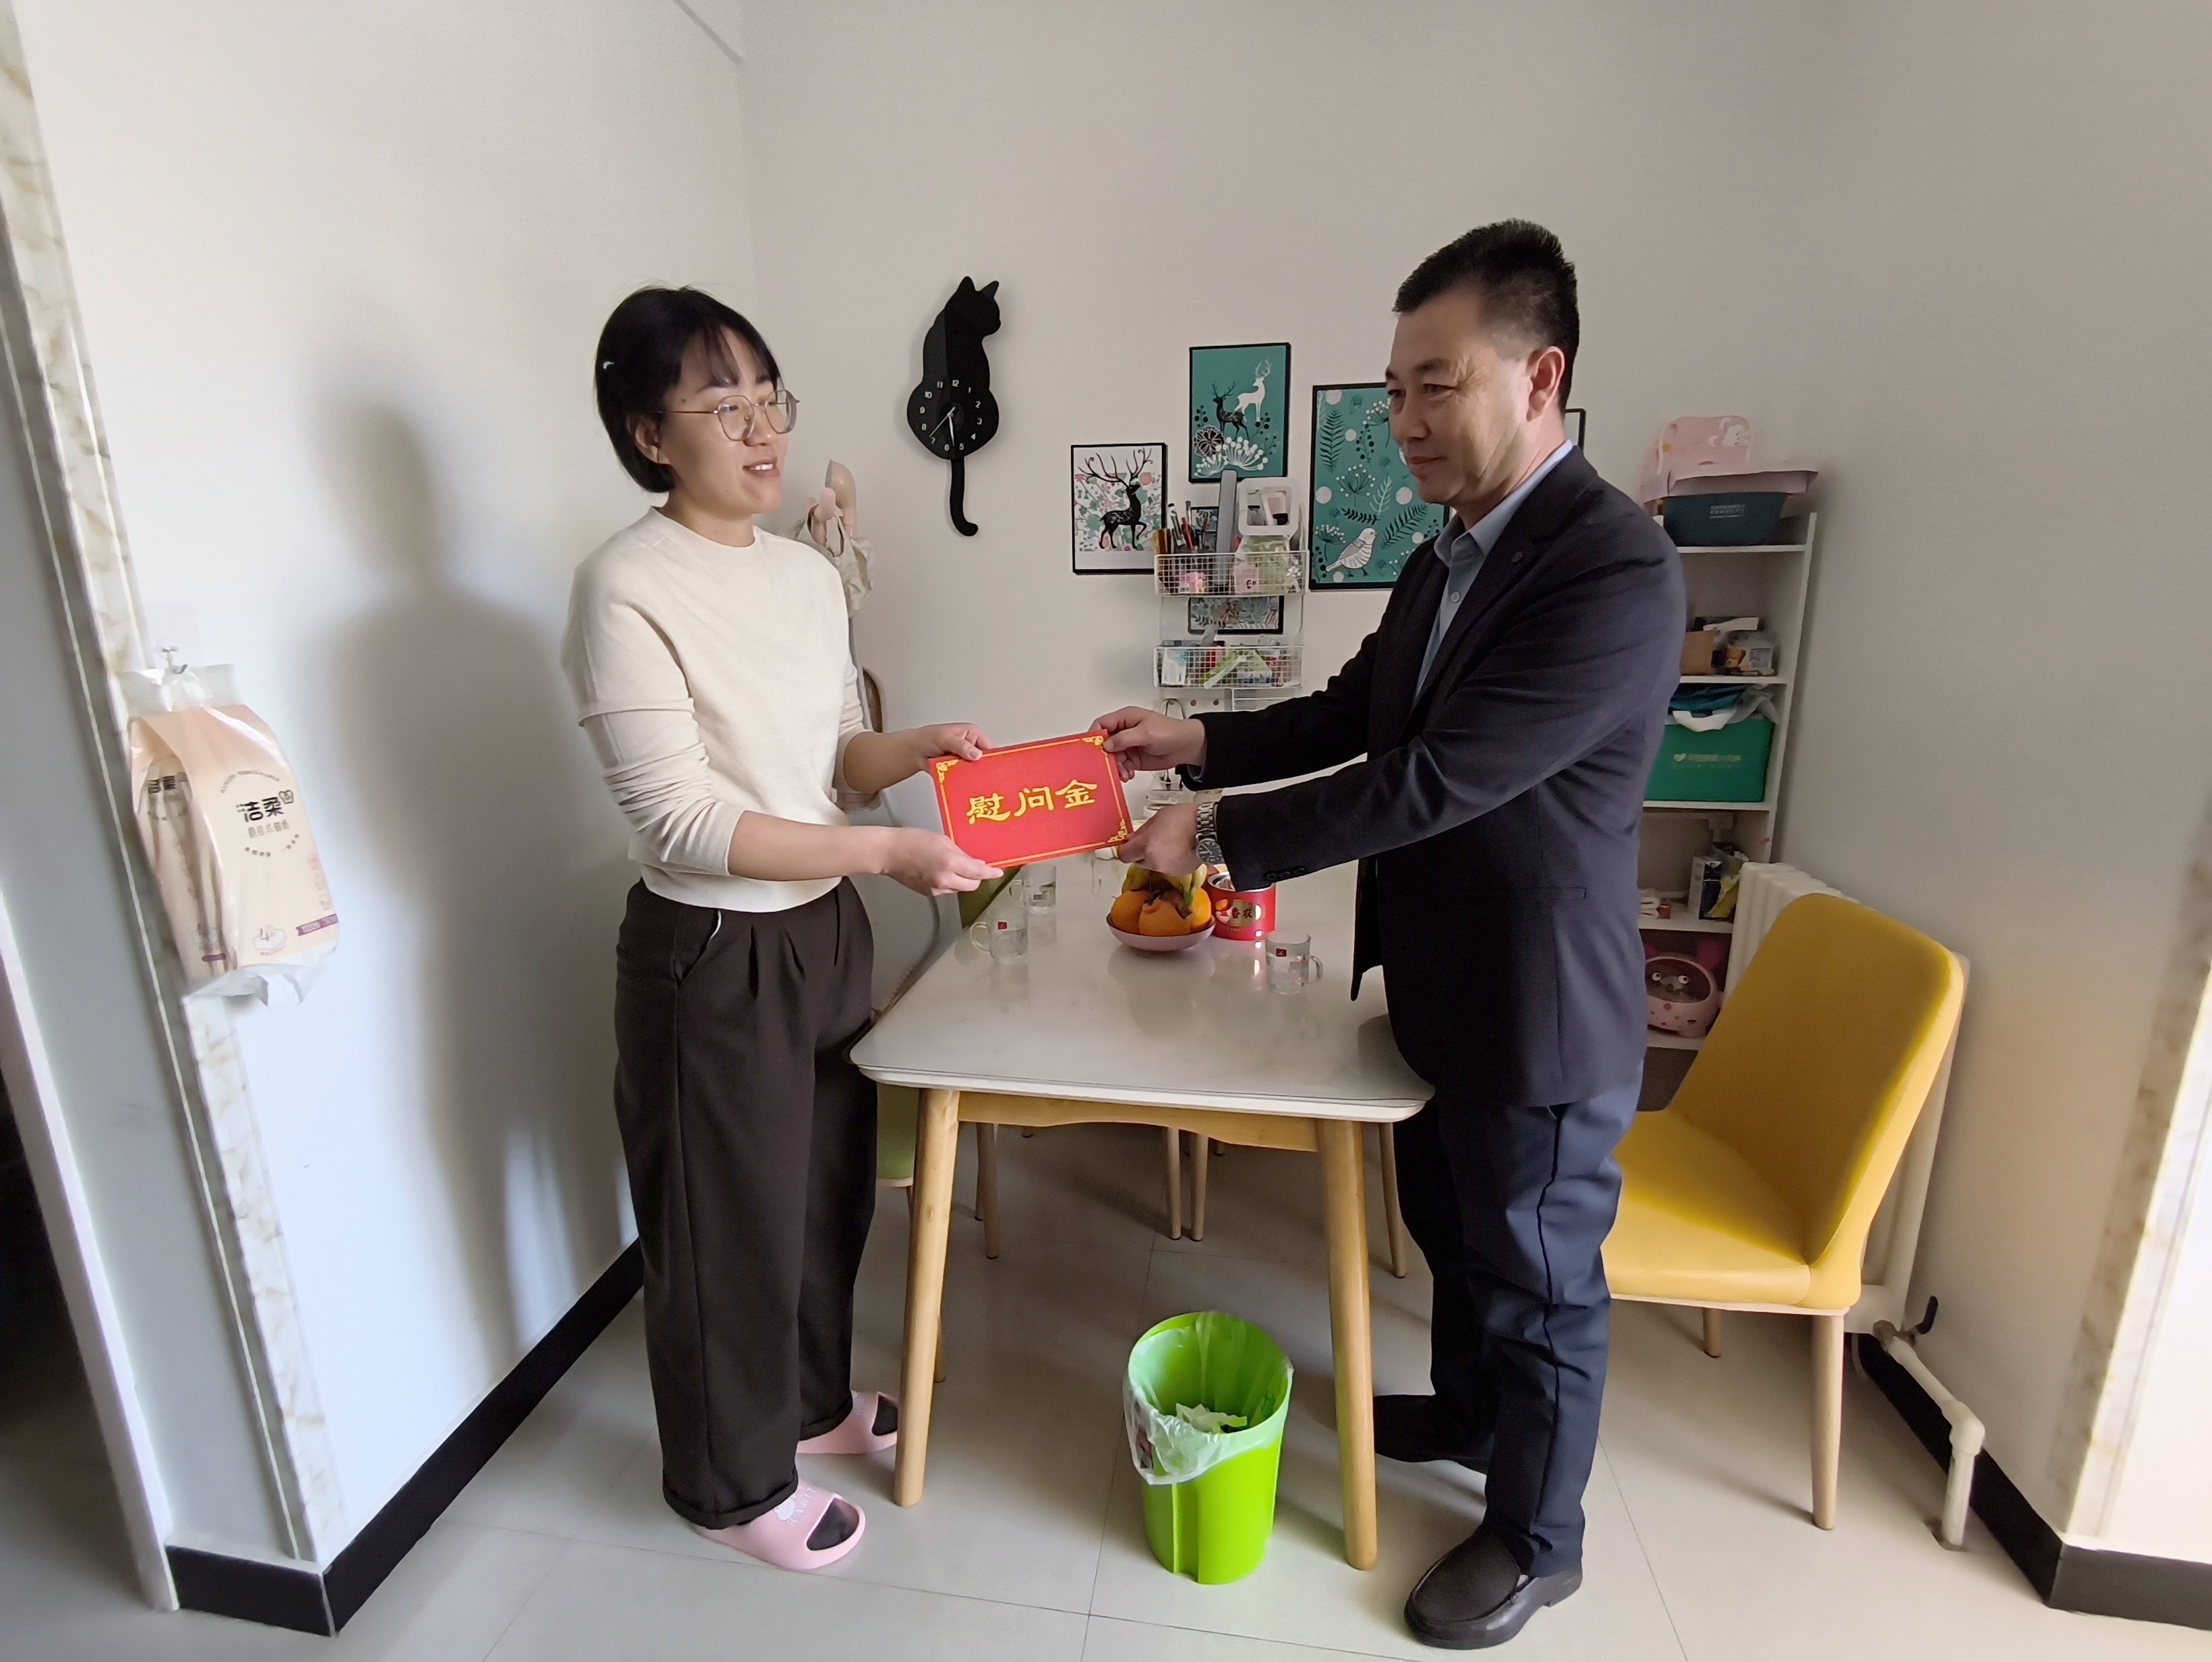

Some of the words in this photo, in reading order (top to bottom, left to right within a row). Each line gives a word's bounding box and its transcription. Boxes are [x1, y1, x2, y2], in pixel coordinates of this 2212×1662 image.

[236, 797, 285, 823] 洁柔
[966, 779, 1098, 825] 慰问金
